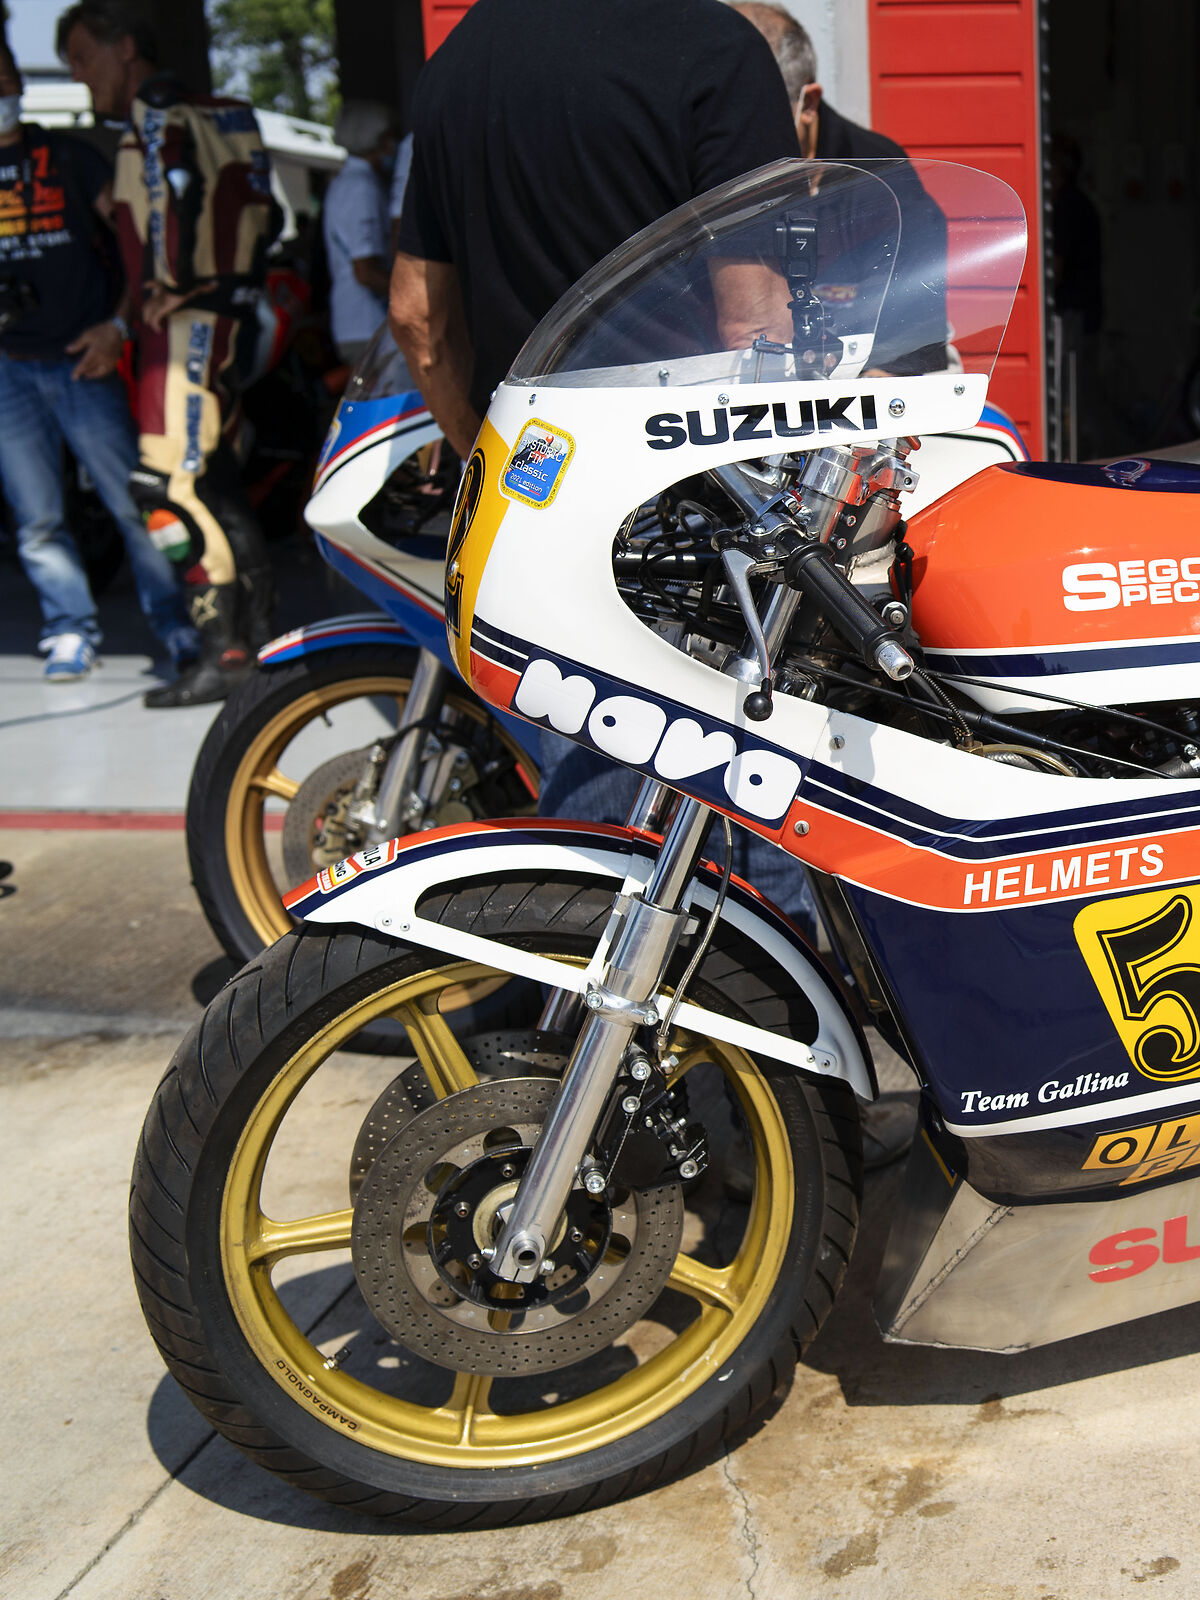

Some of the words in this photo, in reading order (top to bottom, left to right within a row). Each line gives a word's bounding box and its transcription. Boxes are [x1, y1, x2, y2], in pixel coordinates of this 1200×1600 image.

[645, 395, 877, 450] SUZUKI
[515, 460, 549, 482] classic
[527, 451, 545, 467] FIM
[522, 480, 543, 493] edition
[963, 844, 1164, 905] HELMETS
[961, 1091, 1030, 1113] Team
[1037, 1072, 1129, 1103] Gallina
[276, 1360, 358, 1430] CAMPAGNOLO
